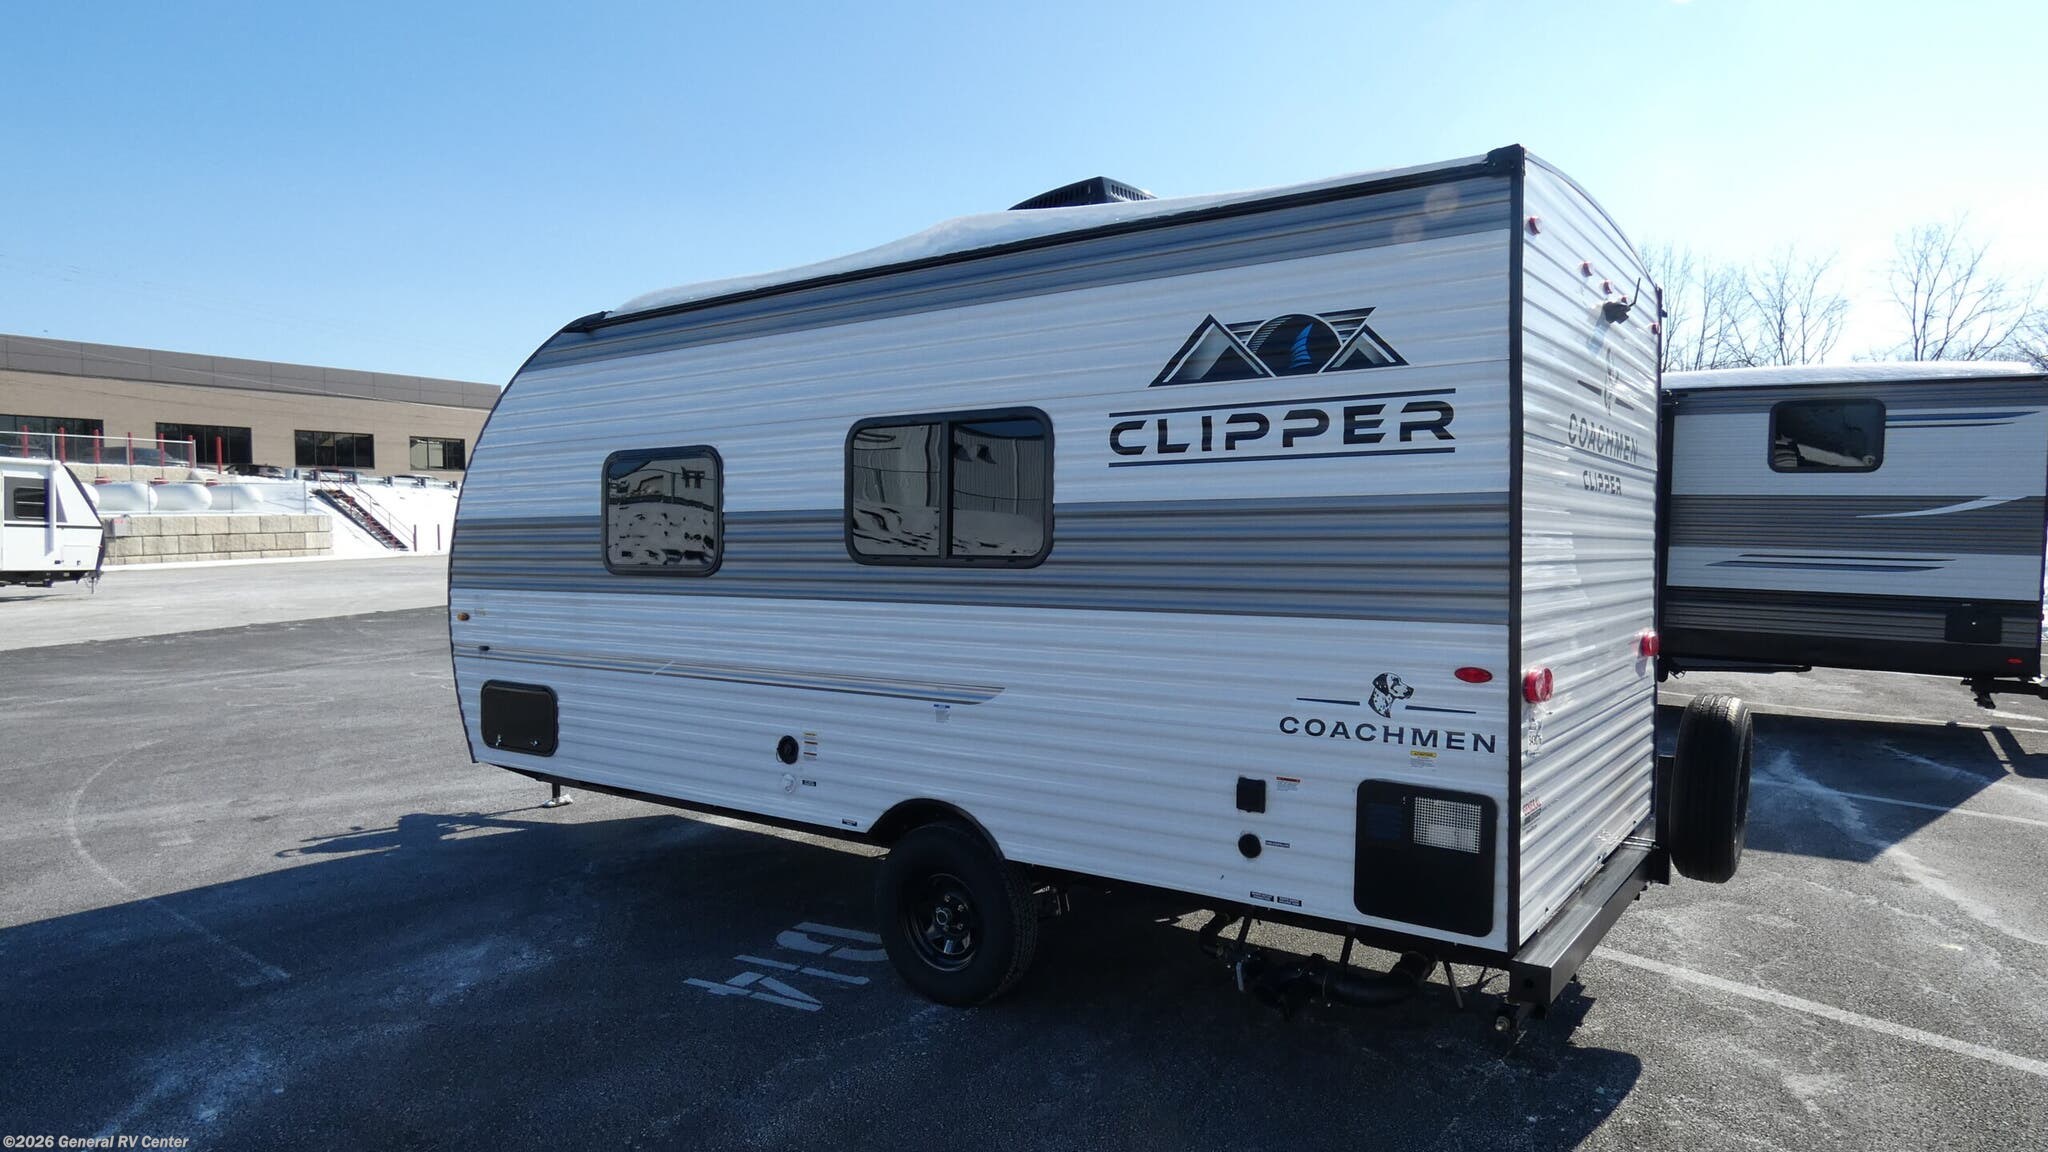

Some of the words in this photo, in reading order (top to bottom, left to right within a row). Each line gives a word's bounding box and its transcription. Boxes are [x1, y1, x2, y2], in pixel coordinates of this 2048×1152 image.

[1109, 401, 1455, 456] CLIPPER
[1568, 413, 1638, 463] COACHMEN
[1583, 470, 1622, 496] CLIPPER
[1279, 716, 1496, 753] COACHMEN
